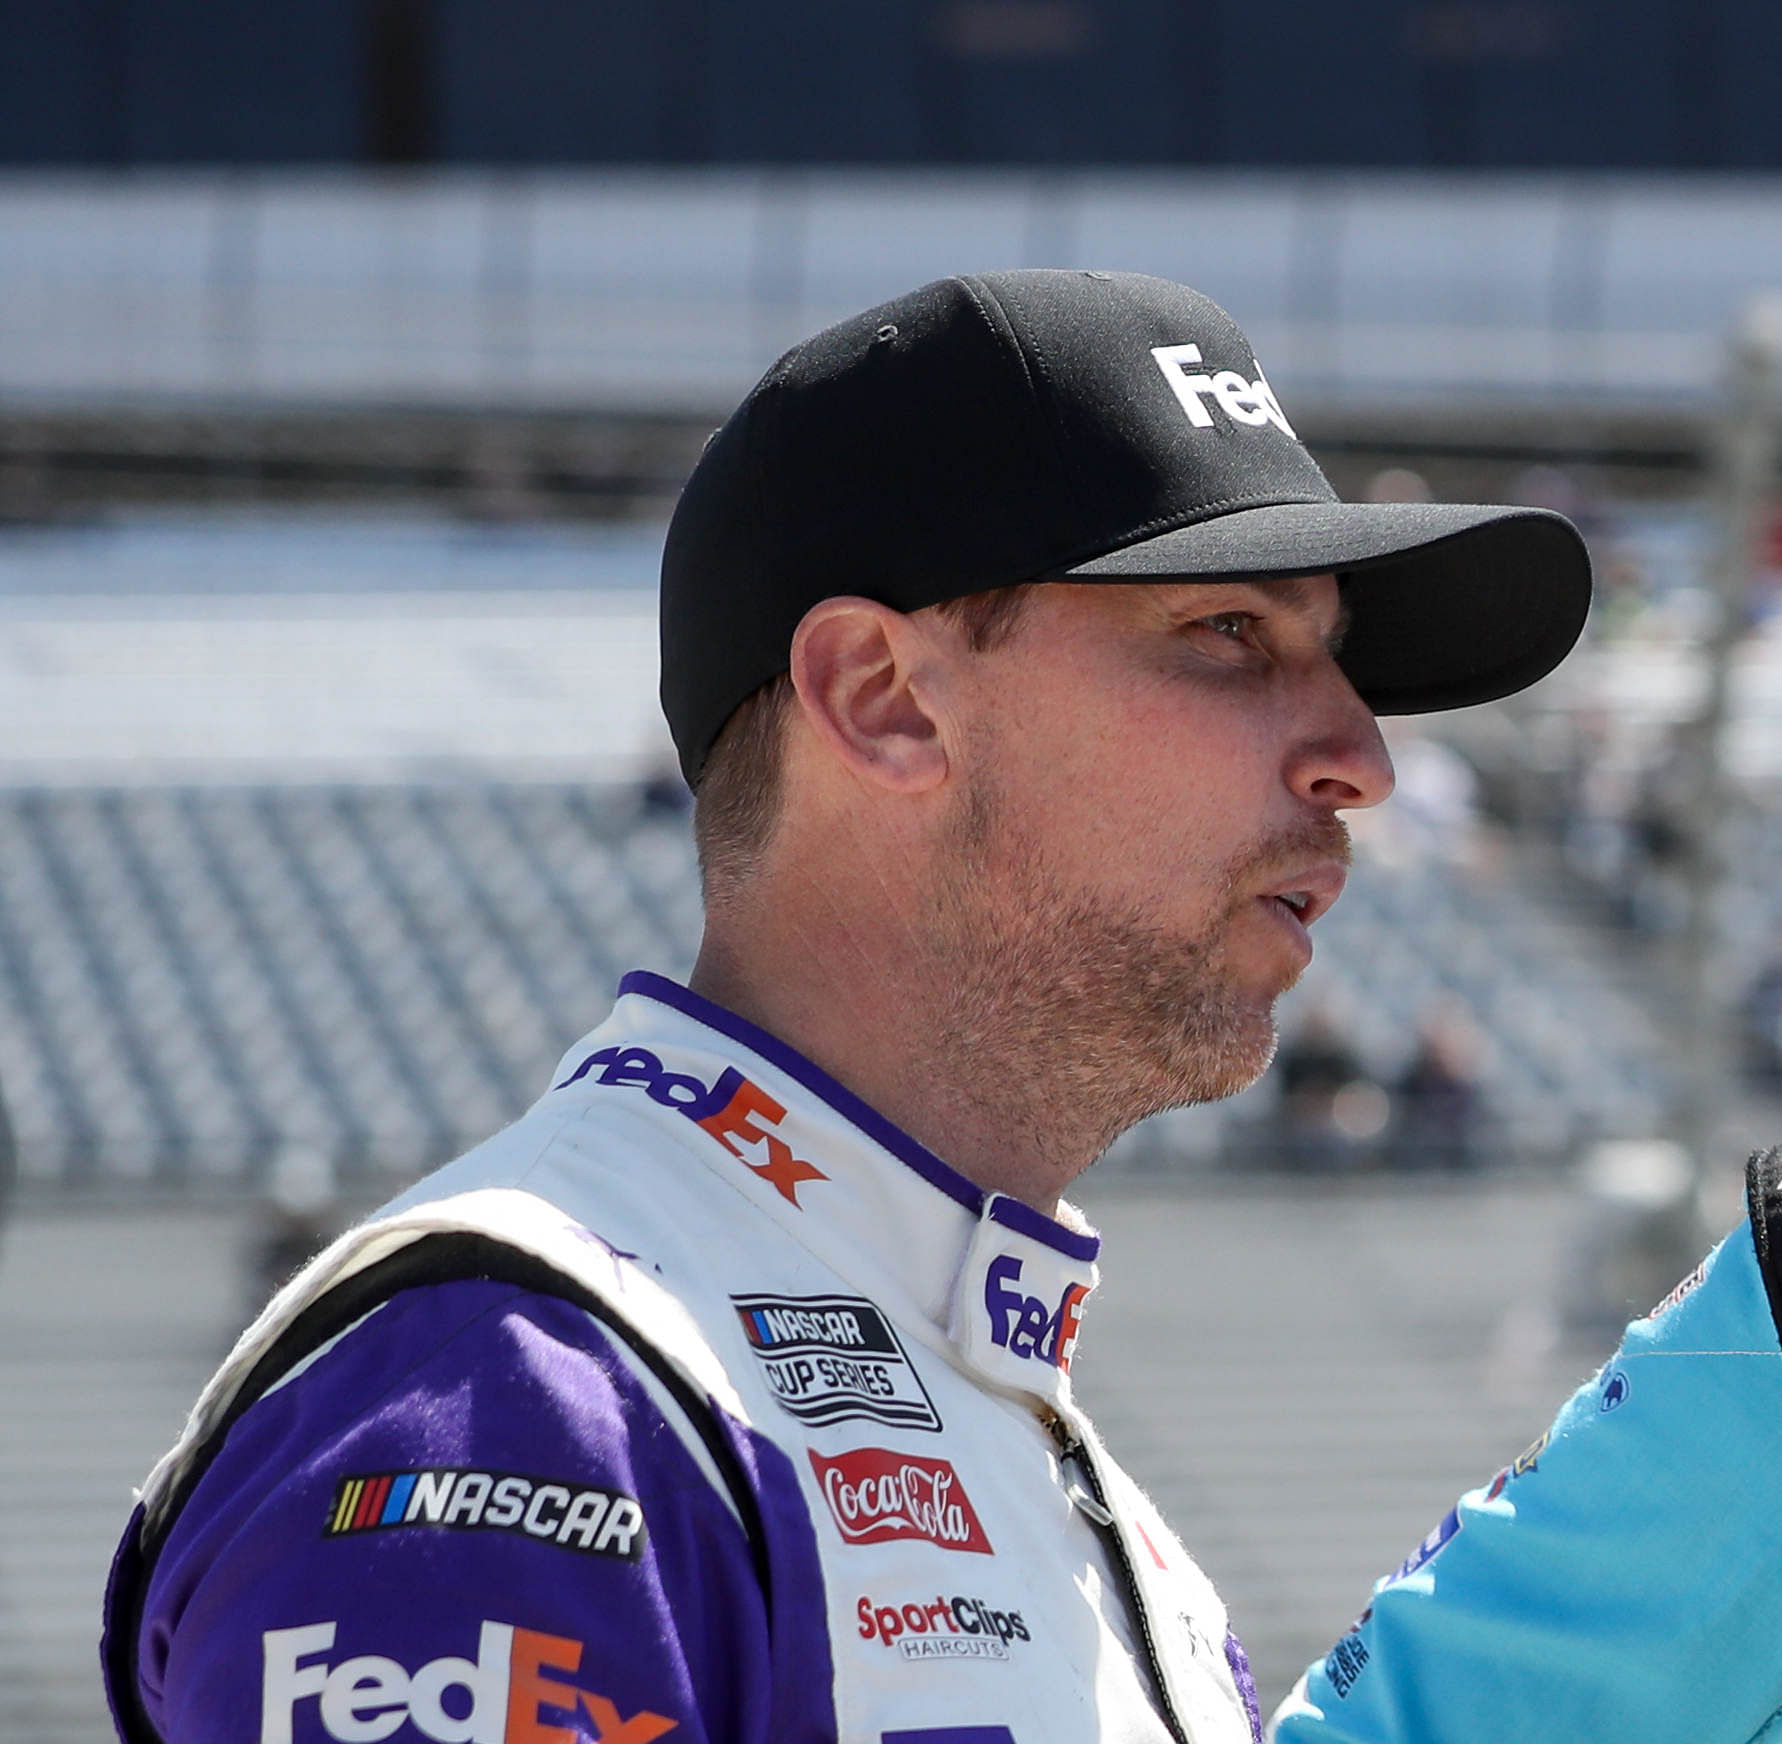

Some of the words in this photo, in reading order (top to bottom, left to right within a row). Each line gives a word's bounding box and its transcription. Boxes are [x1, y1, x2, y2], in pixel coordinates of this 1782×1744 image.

[763, 1308, 866, 1345] NASCAR
[765, 1359, 816, 1396] CUP
[816, 1358, 896, 1397] SERIES
[402, 1471, 644, 1555] NASCAR
[857, 1596, 1032, 1647] SportClips
[903, 1637, 1004, 1659] HAIRCUTS
